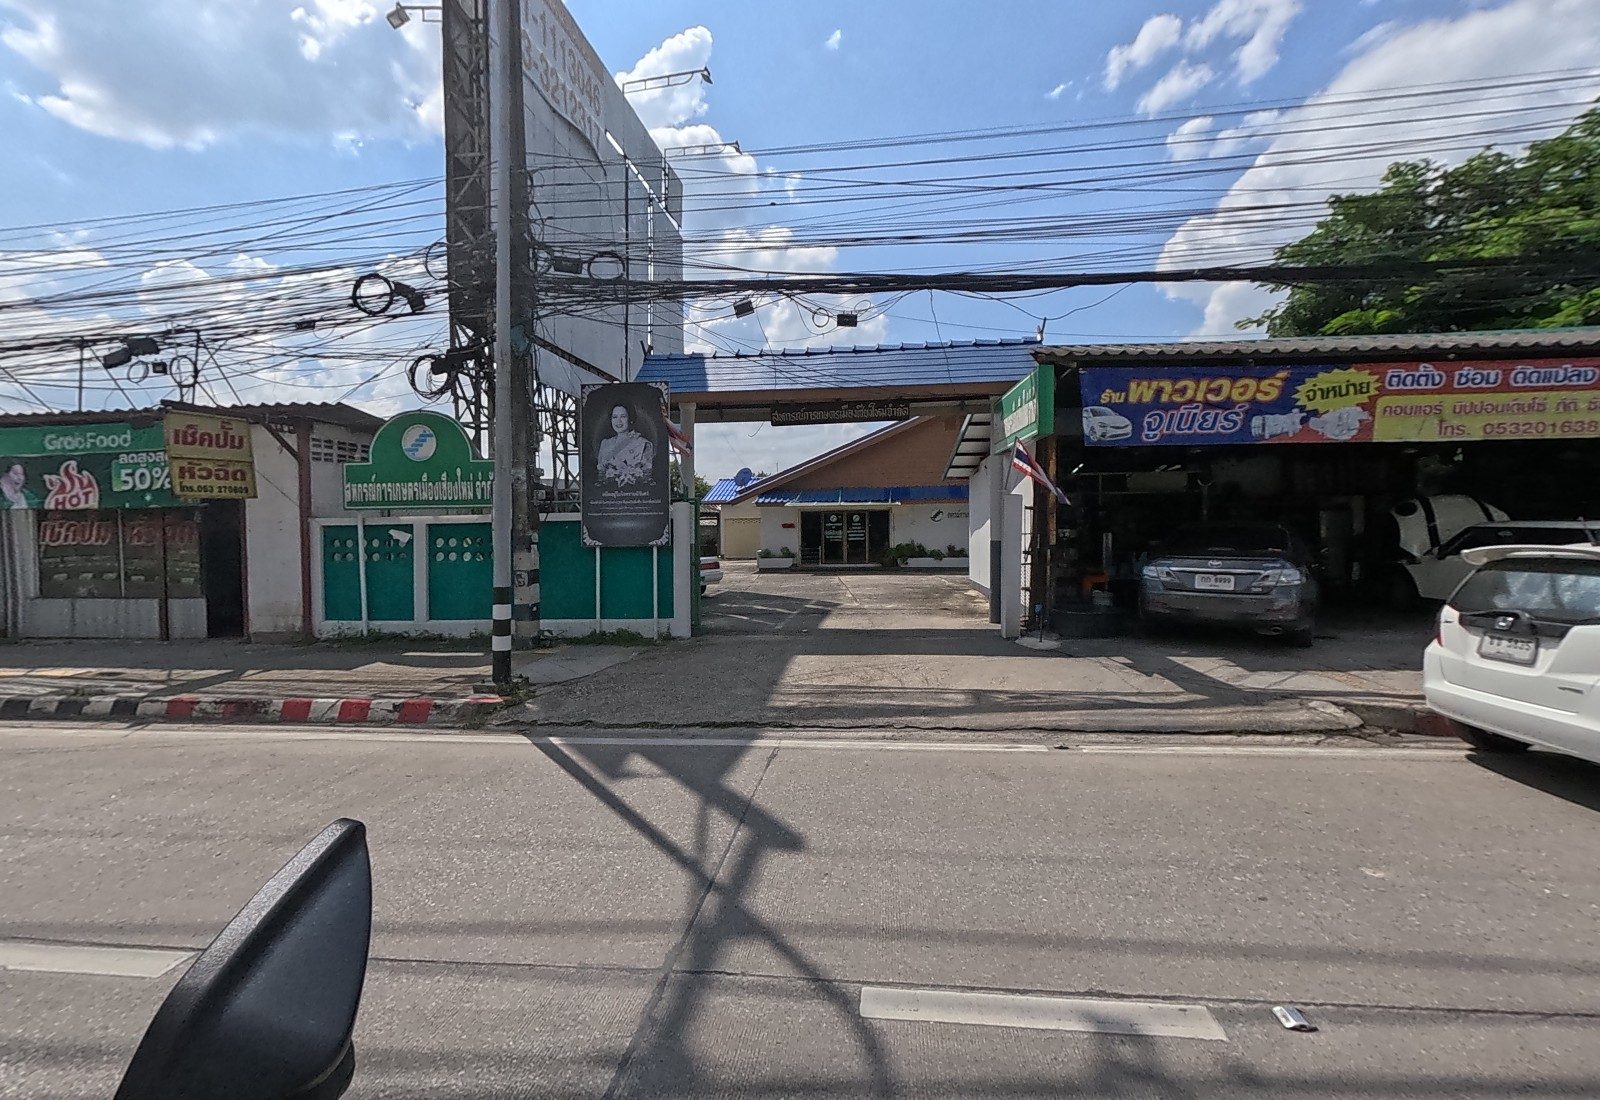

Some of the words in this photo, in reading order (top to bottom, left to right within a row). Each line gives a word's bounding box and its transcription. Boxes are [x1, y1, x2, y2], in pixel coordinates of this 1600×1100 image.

[1101, 390, 1125, 404] ร้าน
[1127, 370, 1291, 404] พาวเวอร์
[1386, 364, 1445, 389] ติดตั้ง
[1453, 367, 1502, 388] ซ่อม
[1509, 364, 1599, 387] ดัดแปลง
[1305, 380, 1372, 403] จำหน่าย
[1142, 404, 1250, 441] จูเนียร์
[1436, 418, 1472, 437] โทร.
[43, 429, 131, 450] GrabFood
[119, 451, 168, 467] ลดสูงสุ
[120, 466, 171, 490] 50%
[54, 490, 93, 509] HOT
